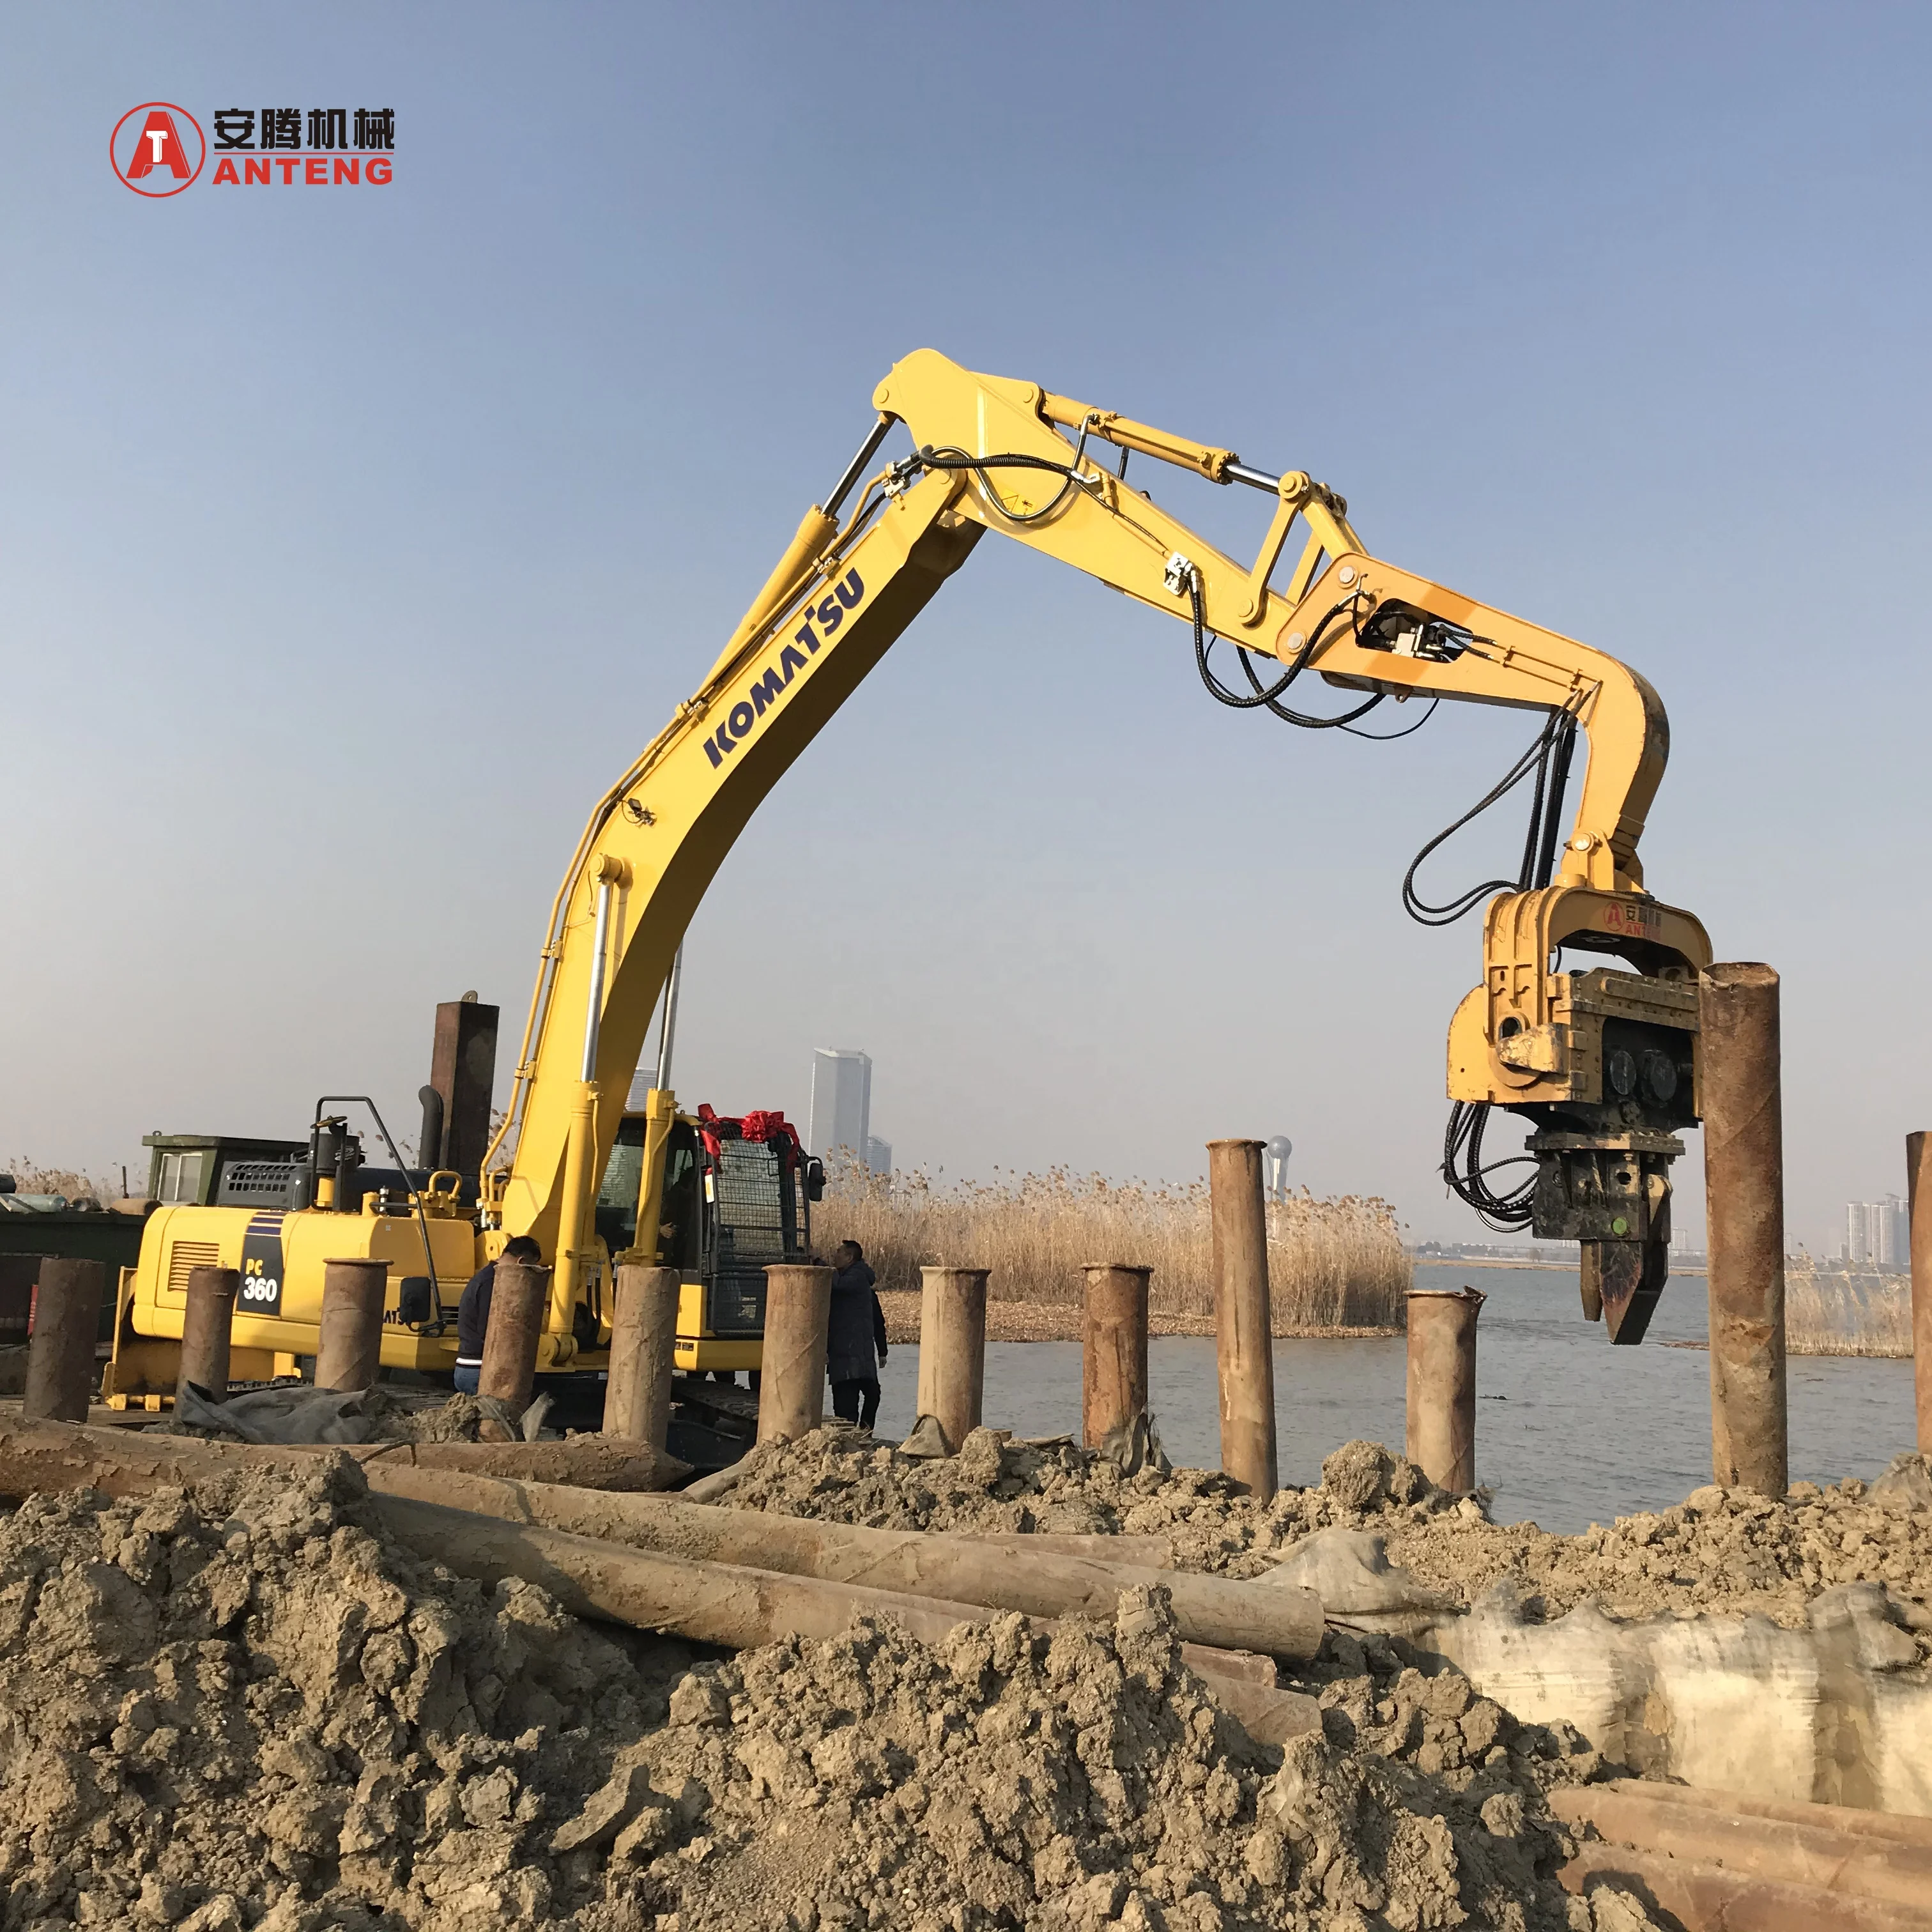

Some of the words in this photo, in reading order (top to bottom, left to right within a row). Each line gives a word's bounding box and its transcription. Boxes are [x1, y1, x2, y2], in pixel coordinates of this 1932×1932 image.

[703, 567, 864, 770] KOMATSU
[245, 1259, 263, 1275] PC
[243, 1276, 277, 1301] 360
